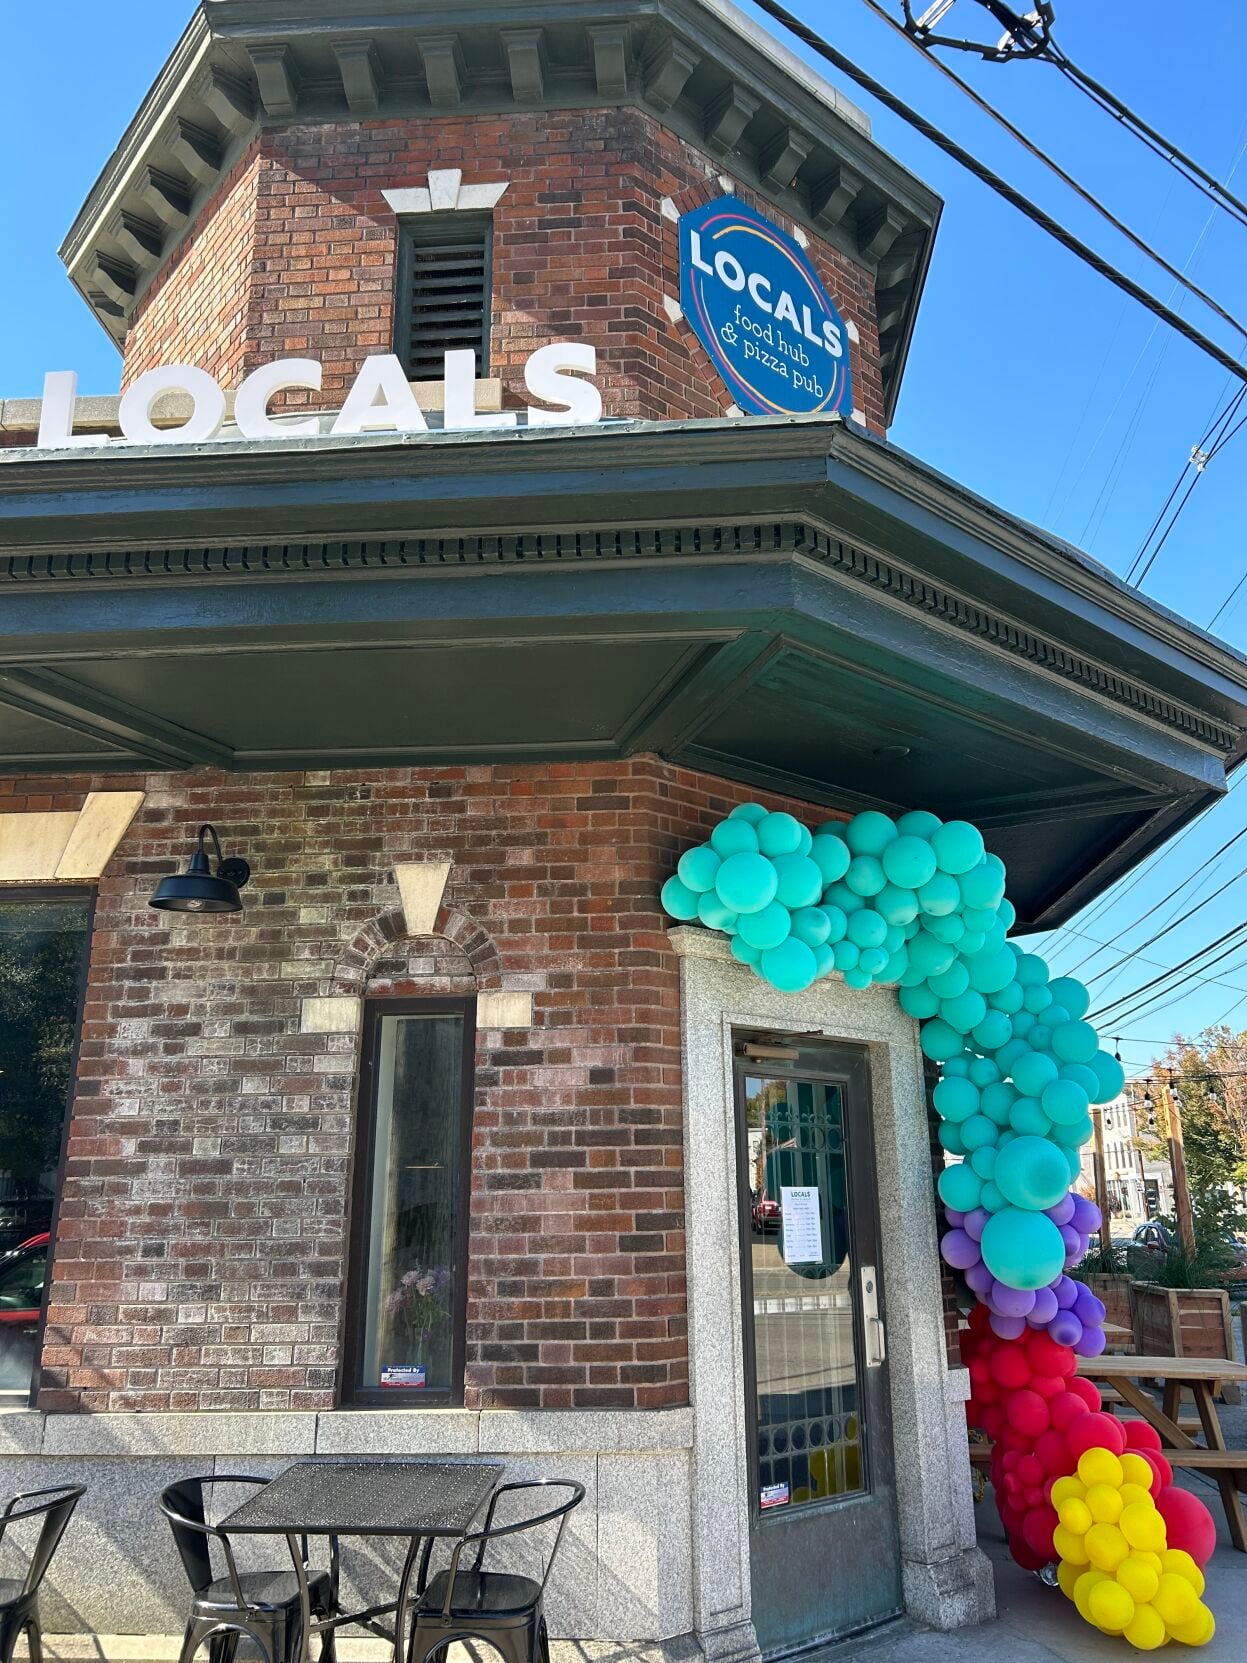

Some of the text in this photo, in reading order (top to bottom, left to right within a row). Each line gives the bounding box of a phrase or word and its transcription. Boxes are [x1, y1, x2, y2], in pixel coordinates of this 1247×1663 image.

[690, 229, 843, 358] LOCALS
[734, 304, 810, 367] food hub
[37, 342, 603, 448] LOCALS
[720, 322, 824, 398] & pizza pub
